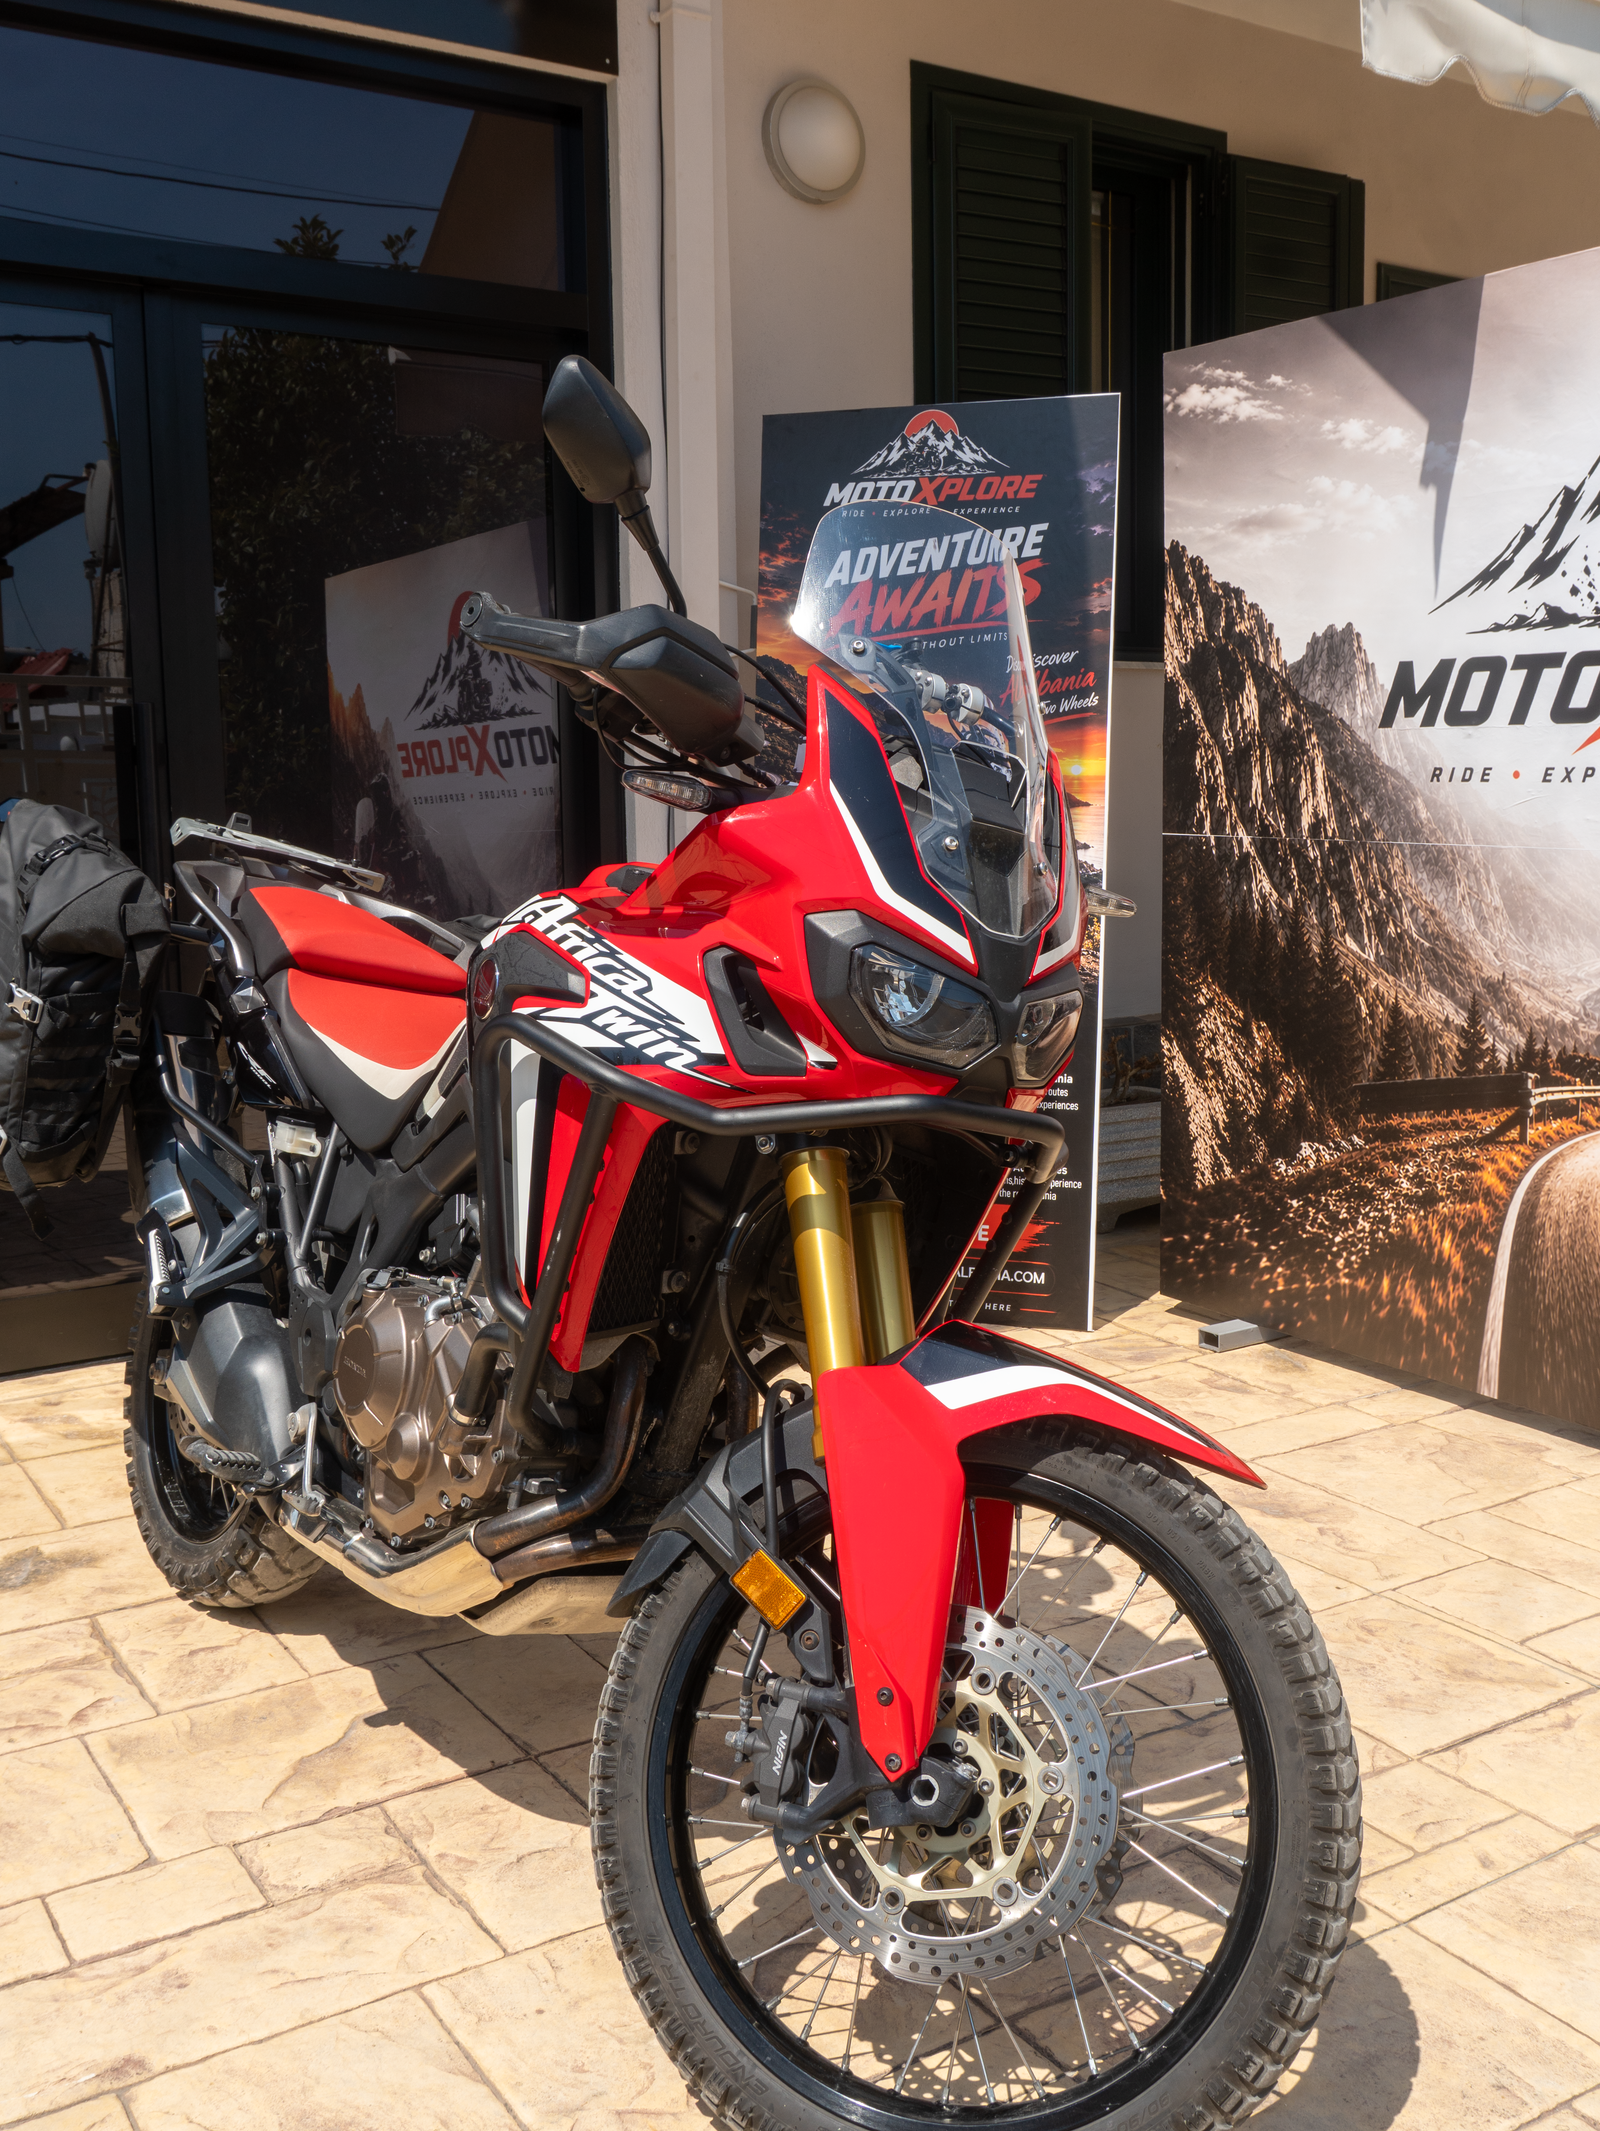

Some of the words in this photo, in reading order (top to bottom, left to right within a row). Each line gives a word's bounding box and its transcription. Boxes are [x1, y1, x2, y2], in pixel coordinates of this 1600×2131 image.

[823, 474, 1043, 507] MOTOXPLORE
[841, 509, 865, 518] RIDE
[882, 506, 931, 518] EXPLORE
[952, 506, 1021, 516] EXPERIENCE
[922, 636, 964, 650] THOUT
[970, 632, 1008, 644] LIMITS
[1059, 691, 1100, 714] Wheels
[1430, 766, 1493, 783] RIDE
[1541, 766, 1596, 783] EXP
[1046, 1087, 1069, 1097] outes
[985, 1302, 1012, 1312] HERE
[772, 1729, 788, 1777] NISSIN
